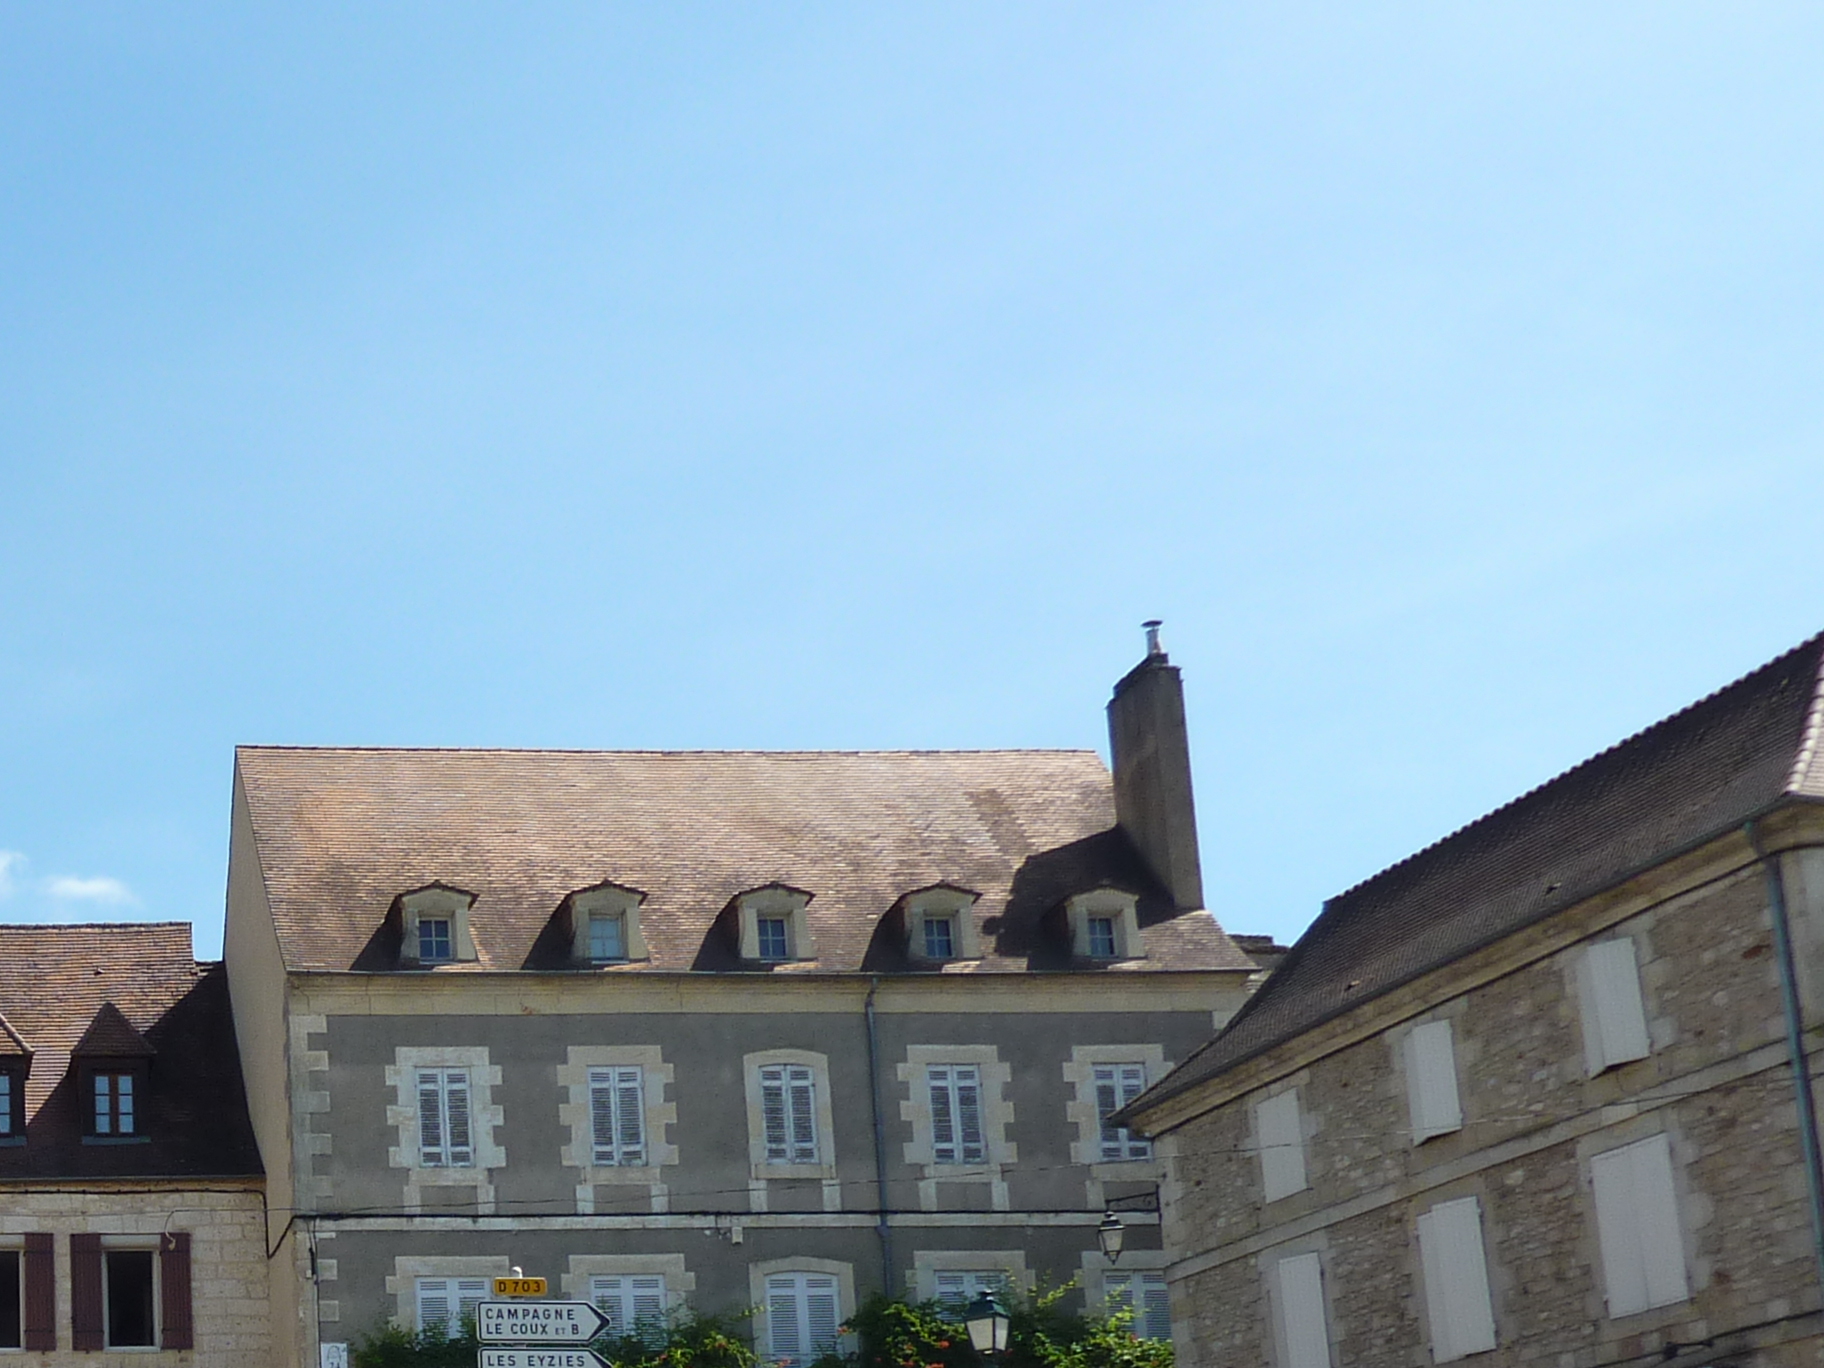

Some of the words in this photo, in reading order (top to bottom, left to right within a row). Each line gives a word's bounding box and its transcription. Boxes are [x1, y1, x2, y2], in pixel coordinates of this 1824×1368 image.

[498, 1281, 507, 1293] D
[512, 1281, 542, 1293] 703
[485, 1308, 575, 1321] CAMPAGNE
[486, 1323, 503, 1335] LE
[510, 1323, 549, 1336] COUX
[487, 1355, 516, 1367] LES
[527, 1355, 585, 1368] EYZIES
